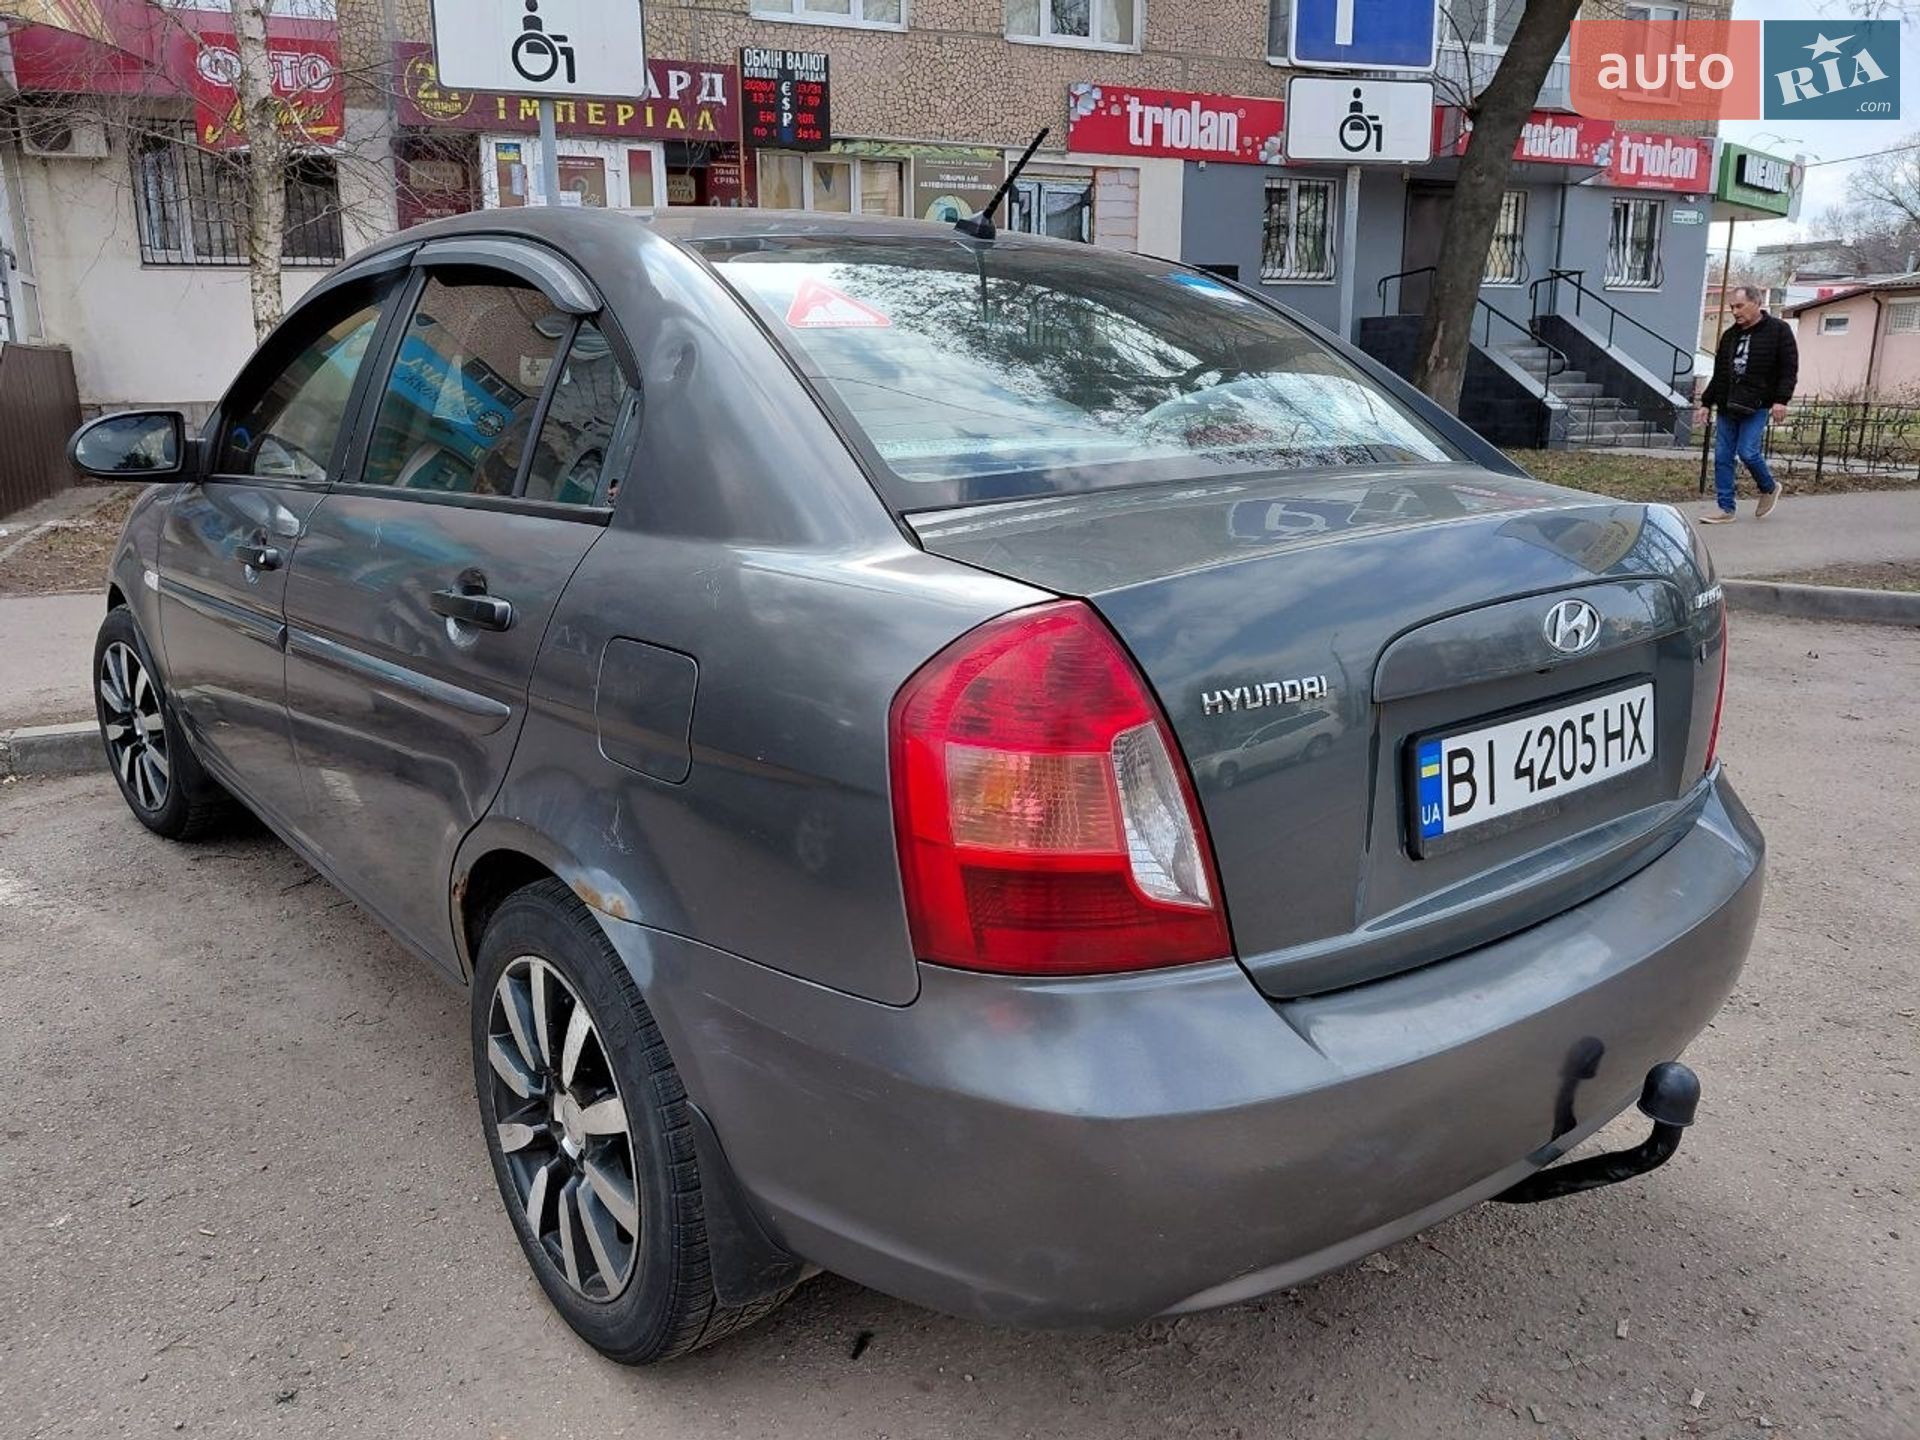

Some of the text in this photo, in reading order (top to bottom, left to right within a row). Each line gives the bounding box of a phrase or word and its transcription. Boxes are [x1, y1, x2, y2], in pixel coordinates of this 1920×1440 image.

[197, 46, 334, 92] ФТО
[744, 49, 826, 71] ОБМІН ВАЛЮТ
[496, 97, 716, 132] ІМПЕРІАЛ
[1126, 96, 1239, 152] triolan
[1521, 118, 1579, 160] iolan
[1619, 135, 1698, 179] triolan
[1201, 675, 1327, 715] HYUNDAI
[1447, 740, 1495, 817] BI
[1514, 712, 1597, 793] 4205
[1421, 804, 1441, 825] UA
